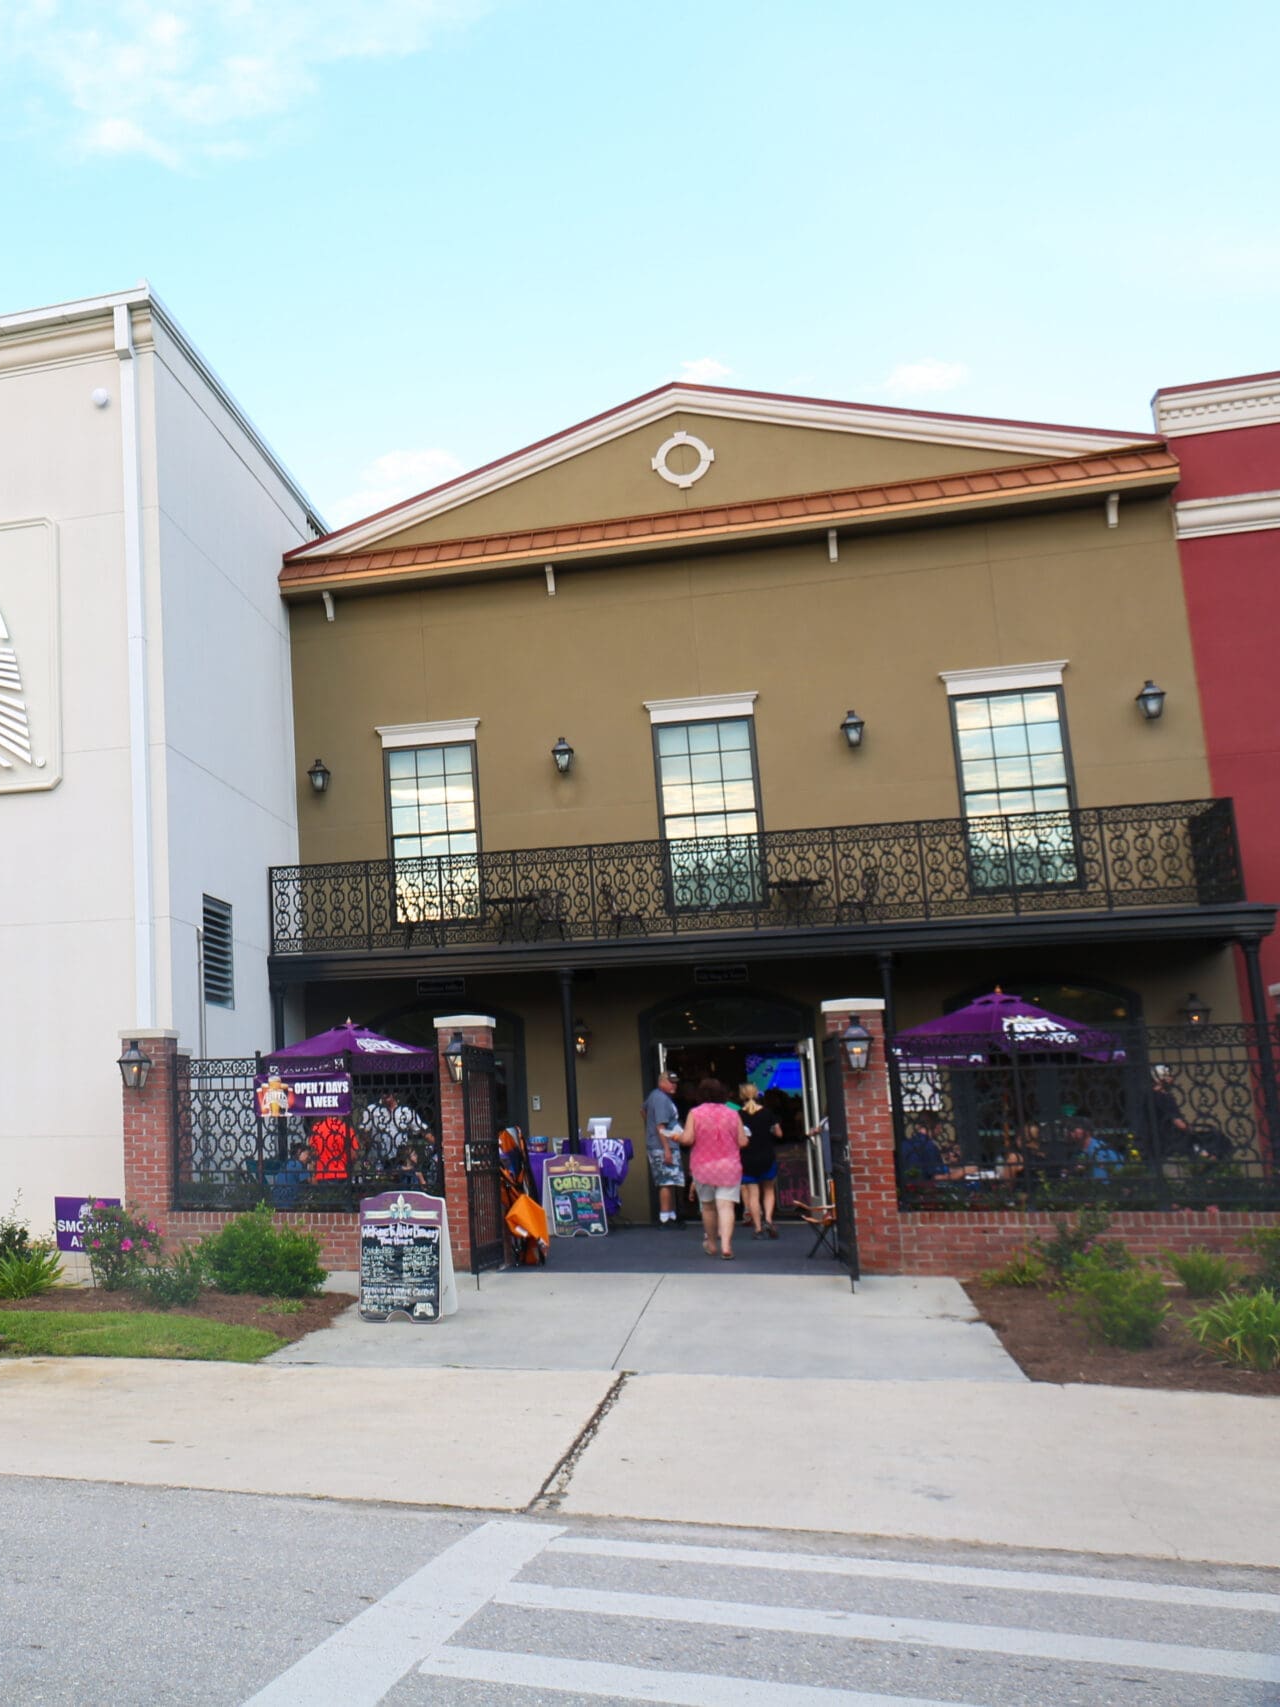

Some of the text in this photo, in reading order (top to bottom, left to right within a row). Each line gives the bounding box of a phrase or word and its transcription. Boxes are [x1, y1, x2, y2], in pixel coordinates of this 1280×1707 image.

[294, 1081, 349, 1094] OPEN 7 DAYS
[305, 1095, 339, 1108] A WEEK
[592, 1139, 625, 1160] ABITA
